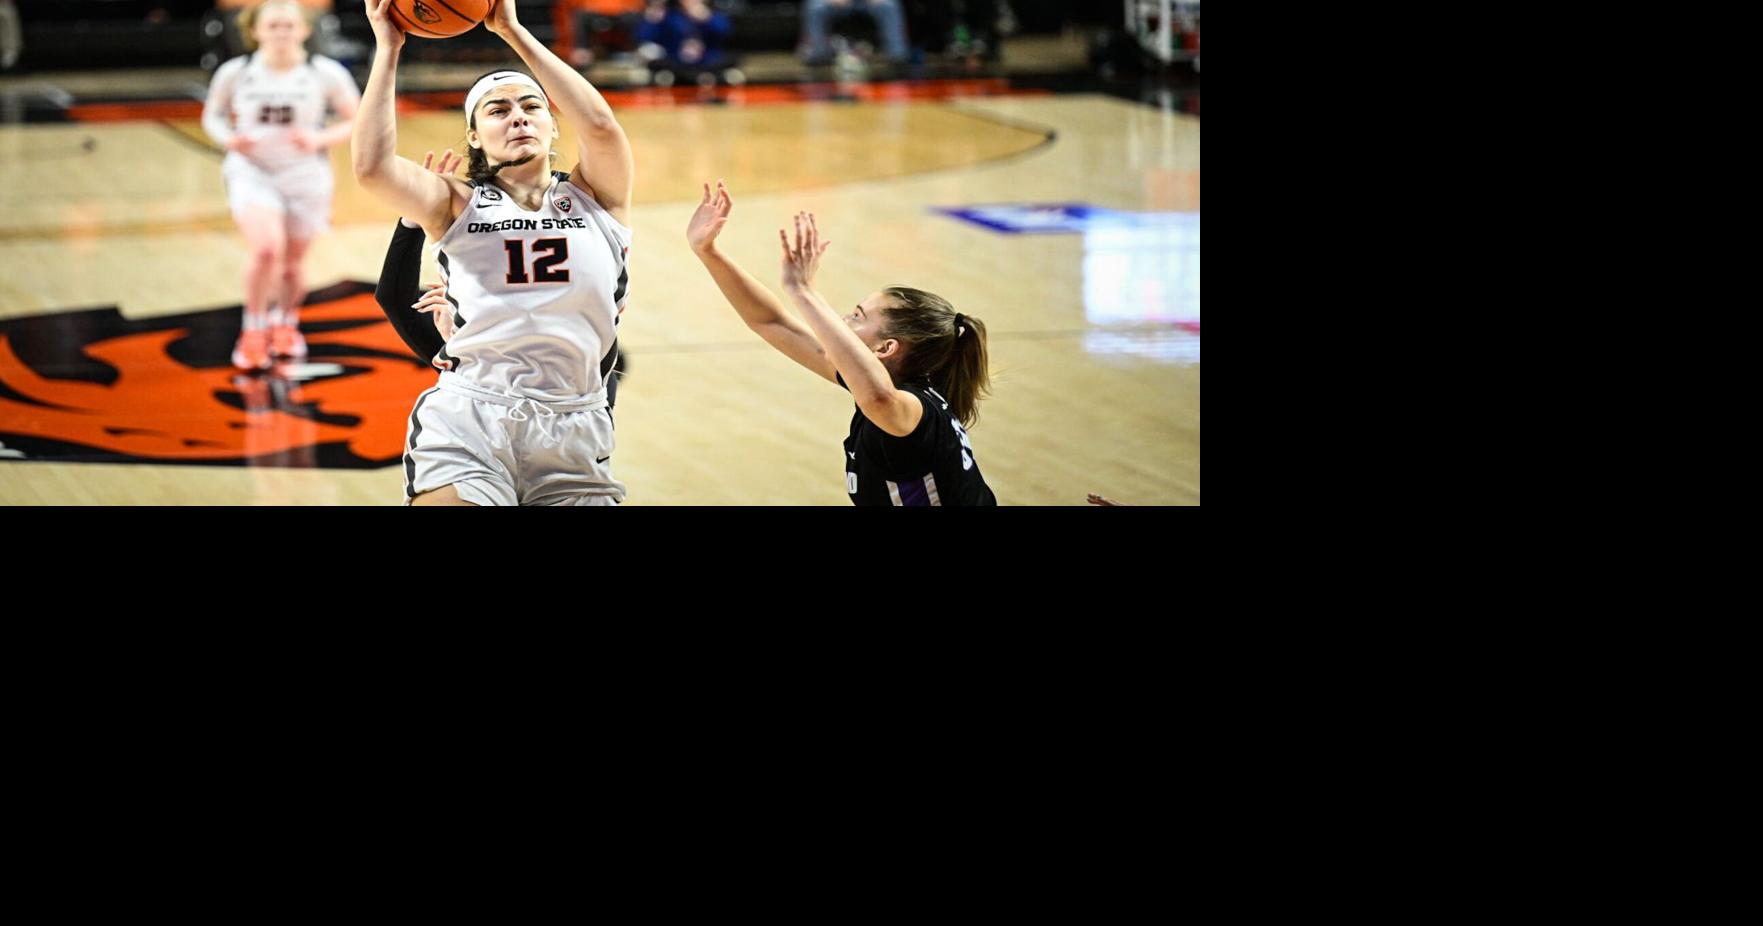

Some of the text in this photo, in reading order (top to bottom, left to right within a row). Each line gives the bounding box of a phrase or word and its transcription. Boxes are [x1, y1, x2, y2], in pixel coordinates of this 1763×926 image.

[467, 217, 586, 234] OREGON STATE
[503, 237, 570, 284] 12
